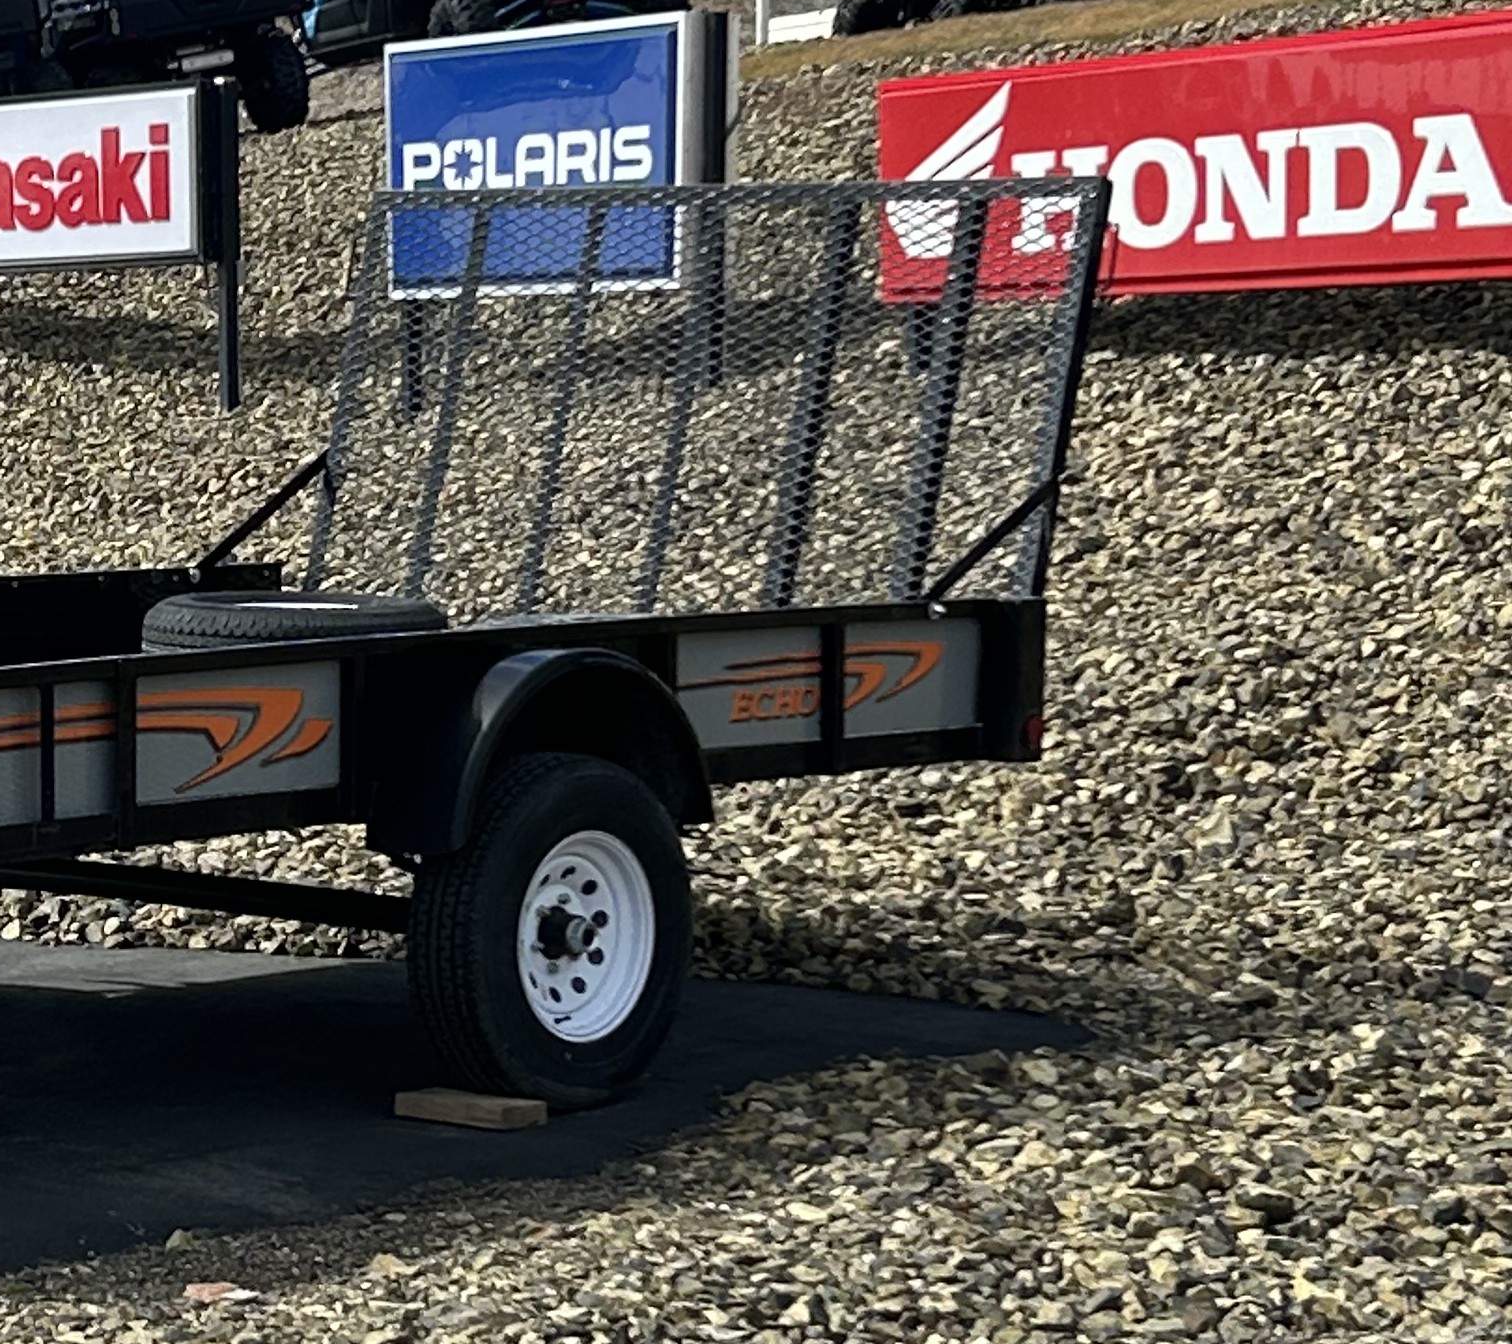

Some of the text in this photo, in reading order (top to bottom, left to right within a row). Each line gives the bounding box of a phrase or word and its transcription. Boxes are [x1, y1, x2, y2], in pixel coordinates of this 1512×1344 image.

[402, 124, 653, 191] POLARIS
[1010, 113, 1512, 253] HONDA
[729, 685, 821, 723] ECHO
